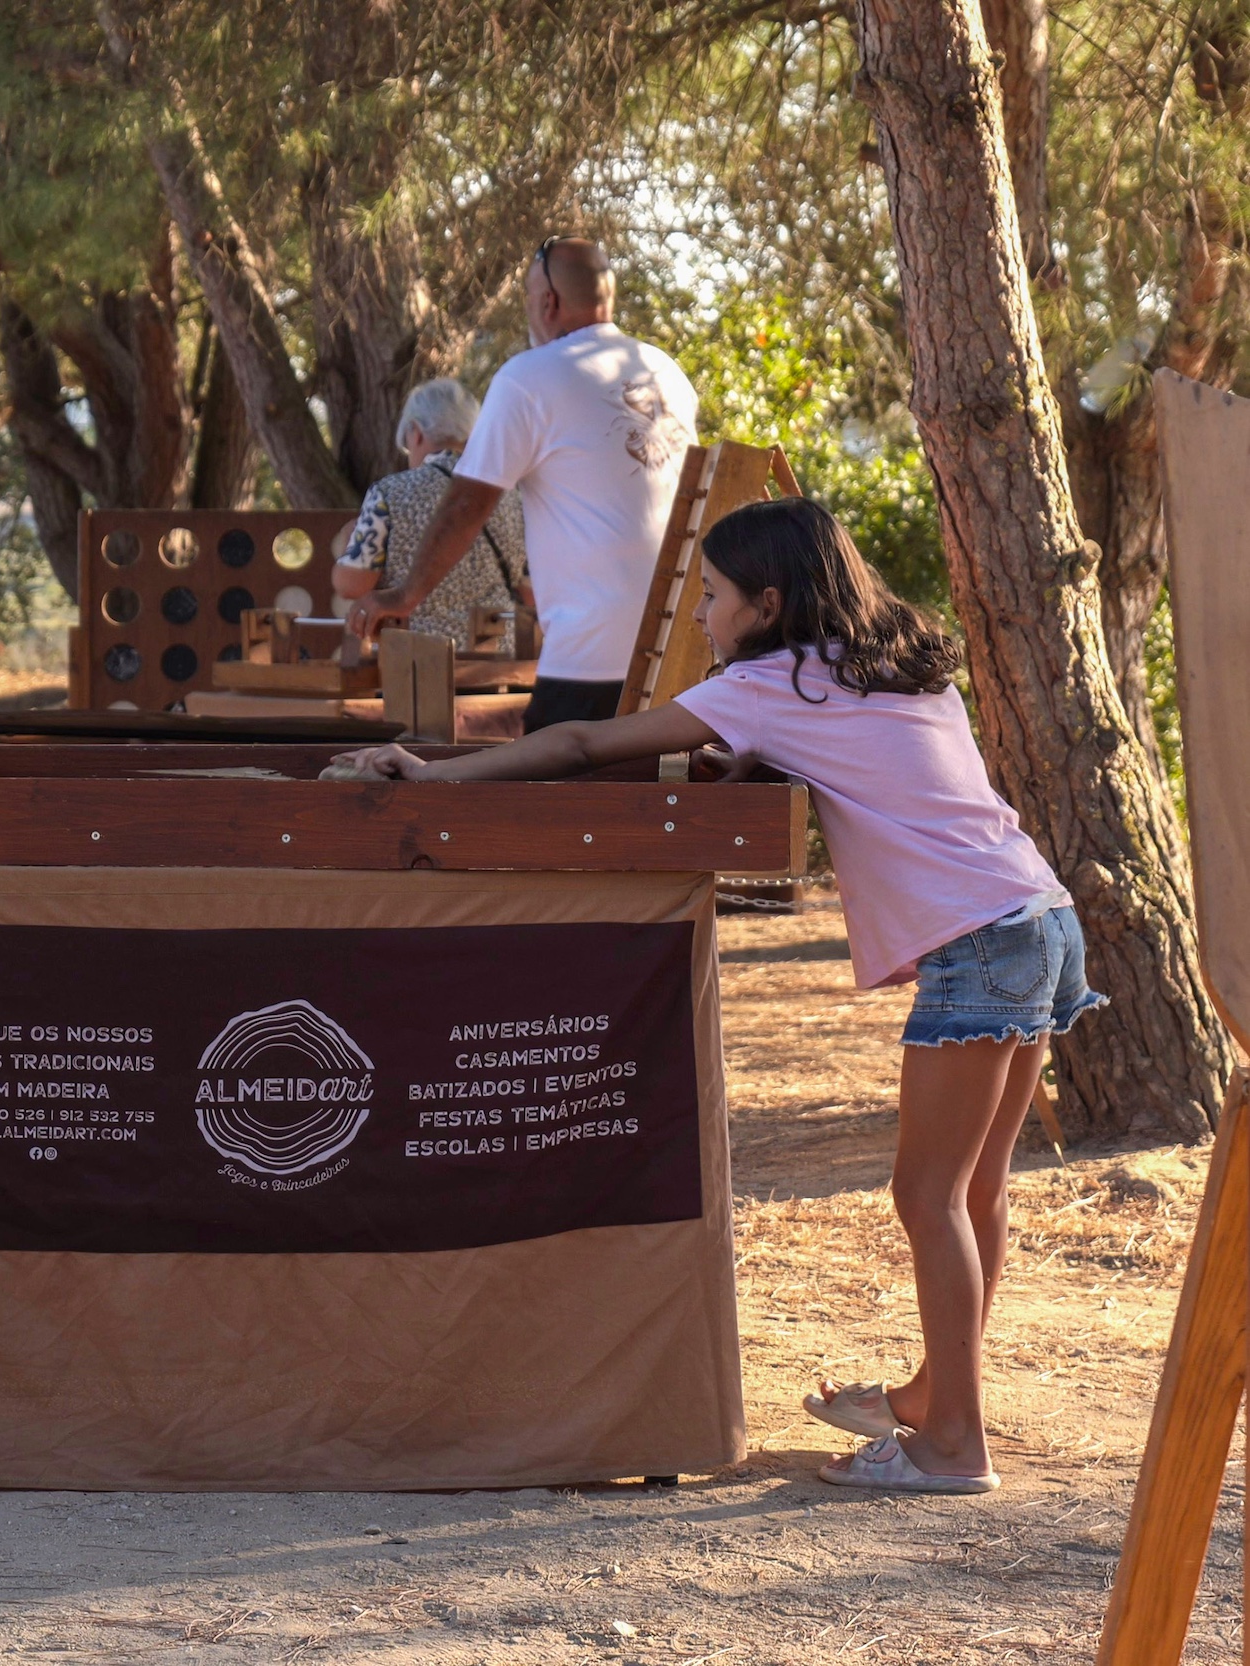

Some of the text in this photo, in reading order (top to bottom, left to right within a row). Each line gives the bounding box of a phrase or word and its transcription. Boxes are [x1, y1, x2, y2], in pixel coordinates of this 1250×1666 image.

[30, 1025, 59, 1042] OS
[67, 1026, 153, 1043] NOSSOS
[449, 1014, 610, 1042] ANIVERSÁRIOS
[10, 1053, 155, 1072] TRADICIONAIS
[455, 1044, 601, 1070] CASAMENTOS
[17, 1082, 110, 1100] MADEIRA
[408, 1078, 526, 1101] BATIZADOS
[545, 1061, 638, 1093] EVENTOS
[14, 1109, 46, 1121] 526
[59, 1110, 84, 1122] 912
[89, 1110, 120, 1123] 532
[124, 1111, 155, 1123] 755
[419, 1090, 626, 1128] FESTAS TEMÁTICAS
[405, 1136, 505, 1157] ESCOLAS
[526, 1117, 639, 1151] EMPRESAS
[217, 1157, 350, 1192] Jogos e Brincadeiras
